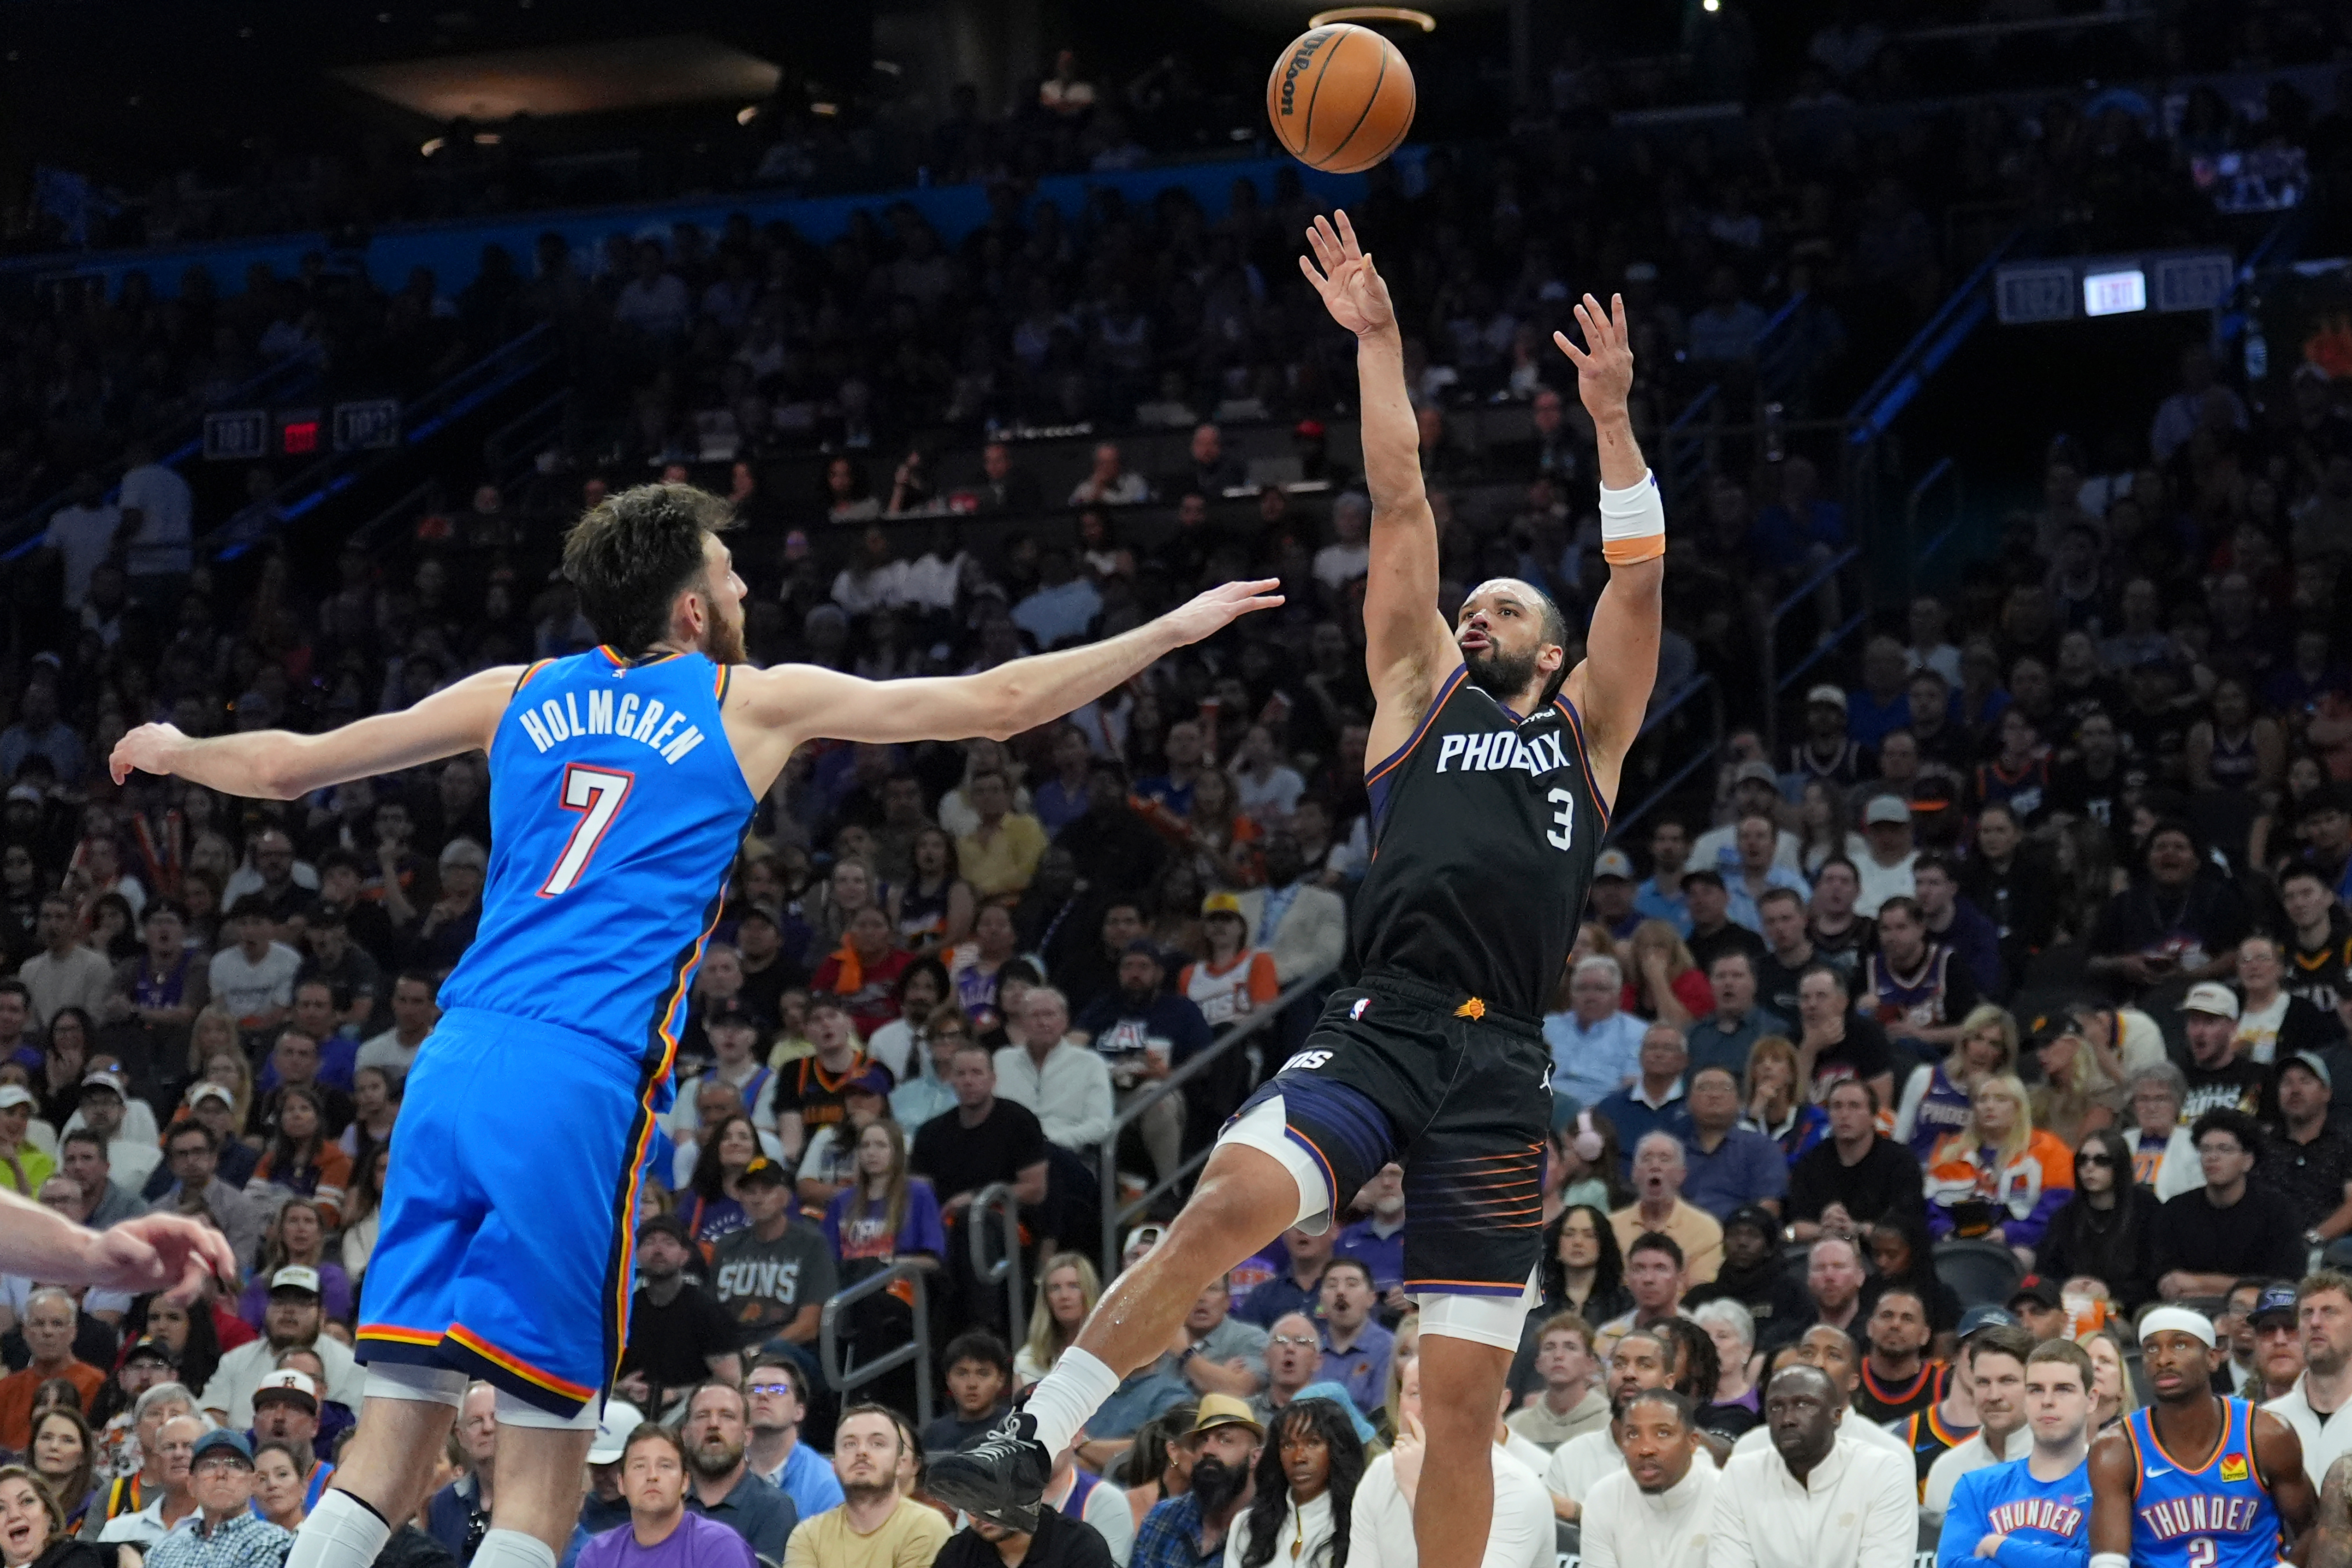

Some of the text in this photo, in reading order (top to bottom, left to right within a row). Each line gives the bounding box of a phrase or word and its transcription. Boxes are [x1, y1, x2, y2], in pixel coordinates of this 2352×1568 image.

[1281, 31, 1337, 116] Wilson
[519, 689, 706, 766] HOLMGREN
[535, 762, 635, 898] 7
[1547, 788, 1574, 851] 3
[718, 1263, 800, 1305] SUNS
[1989, 1498, 2084, 1538] THUNDER
[2140, 1496, 2258, 1541] THUNDER
[2189, 1537, 2216, 1568] 2
